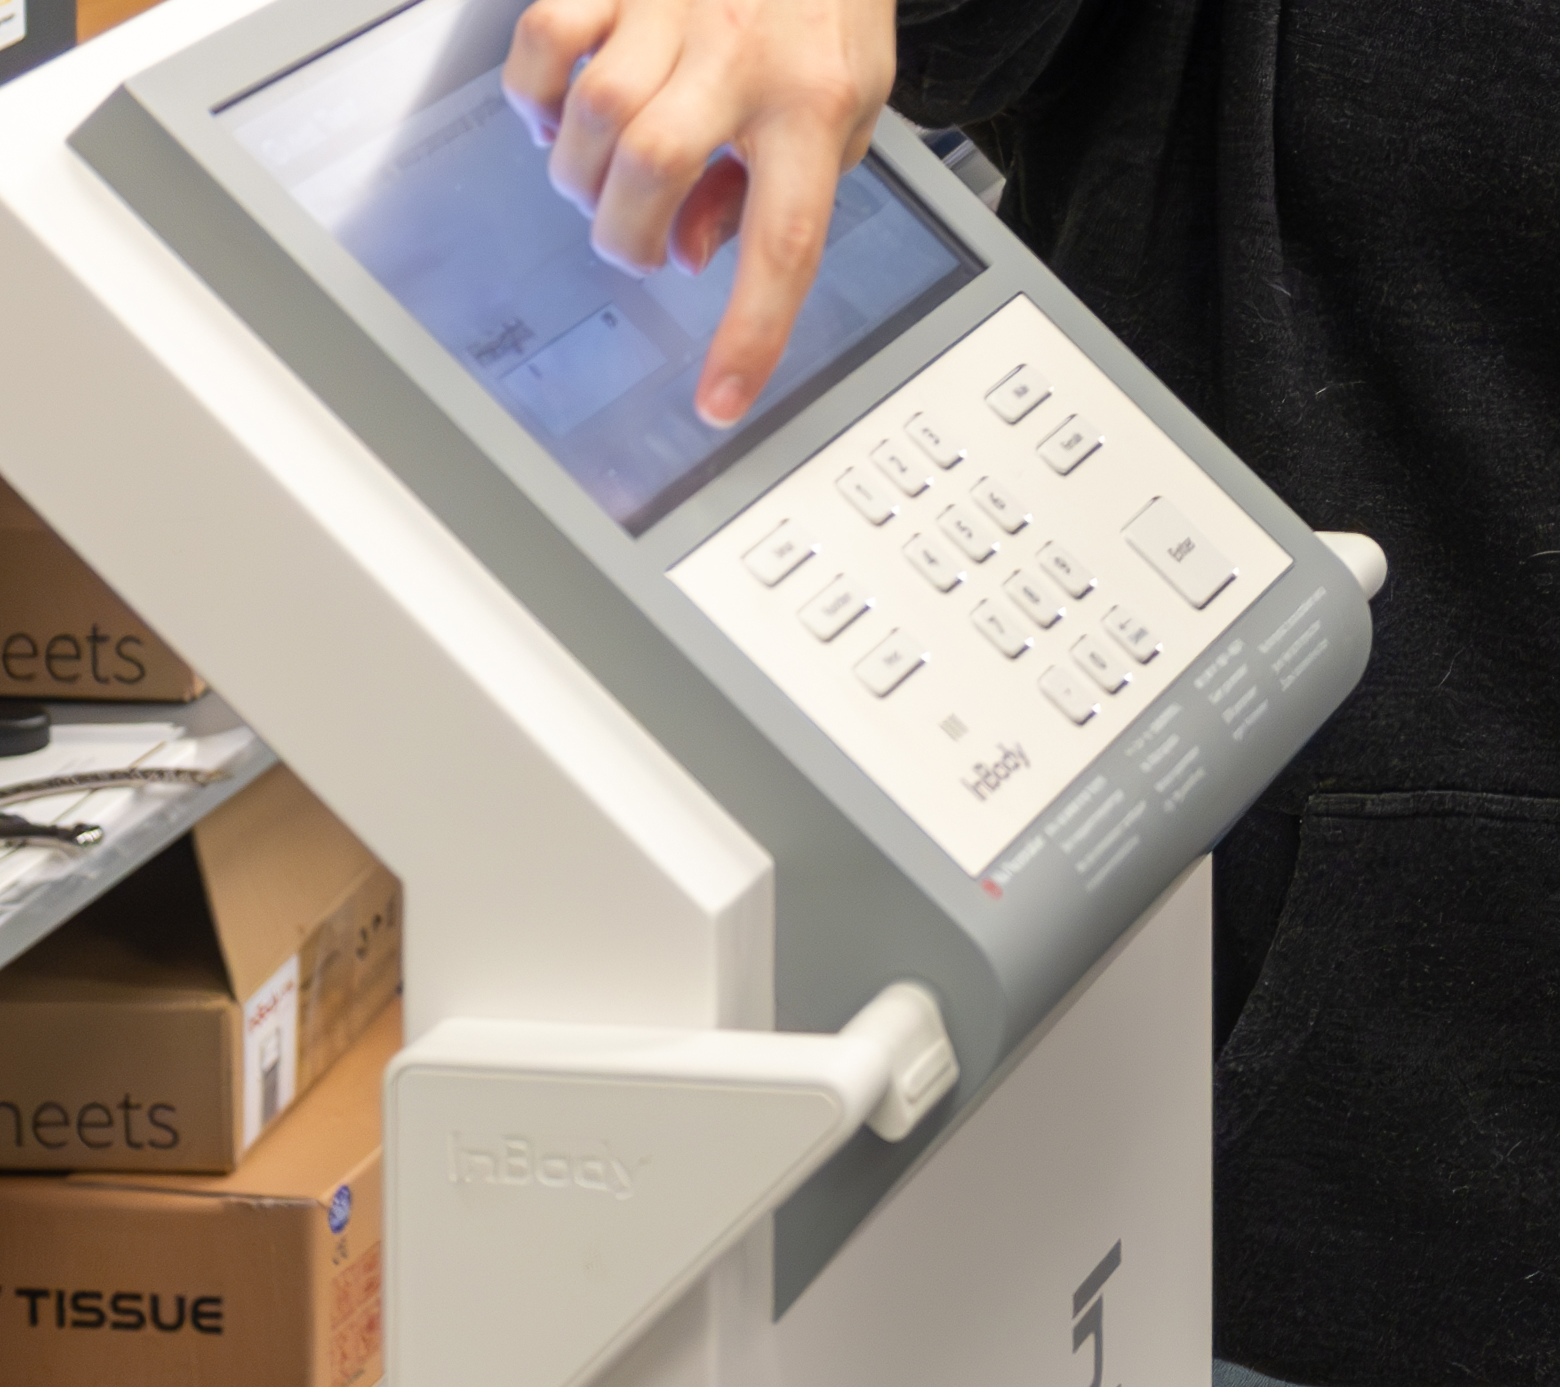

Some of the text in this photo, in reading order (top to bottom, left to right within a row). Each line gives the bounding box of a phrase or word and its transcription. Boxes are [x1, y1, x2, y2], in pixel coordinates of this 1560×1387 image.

[921, 427, 941, 445] 3
[1167, 536, 1197, 564] Enter
[960, 741, 1031, 802] InBody
[447, 1130, 651, 1200] InBody
[15, 1286, 224, 1335] TISSUE
